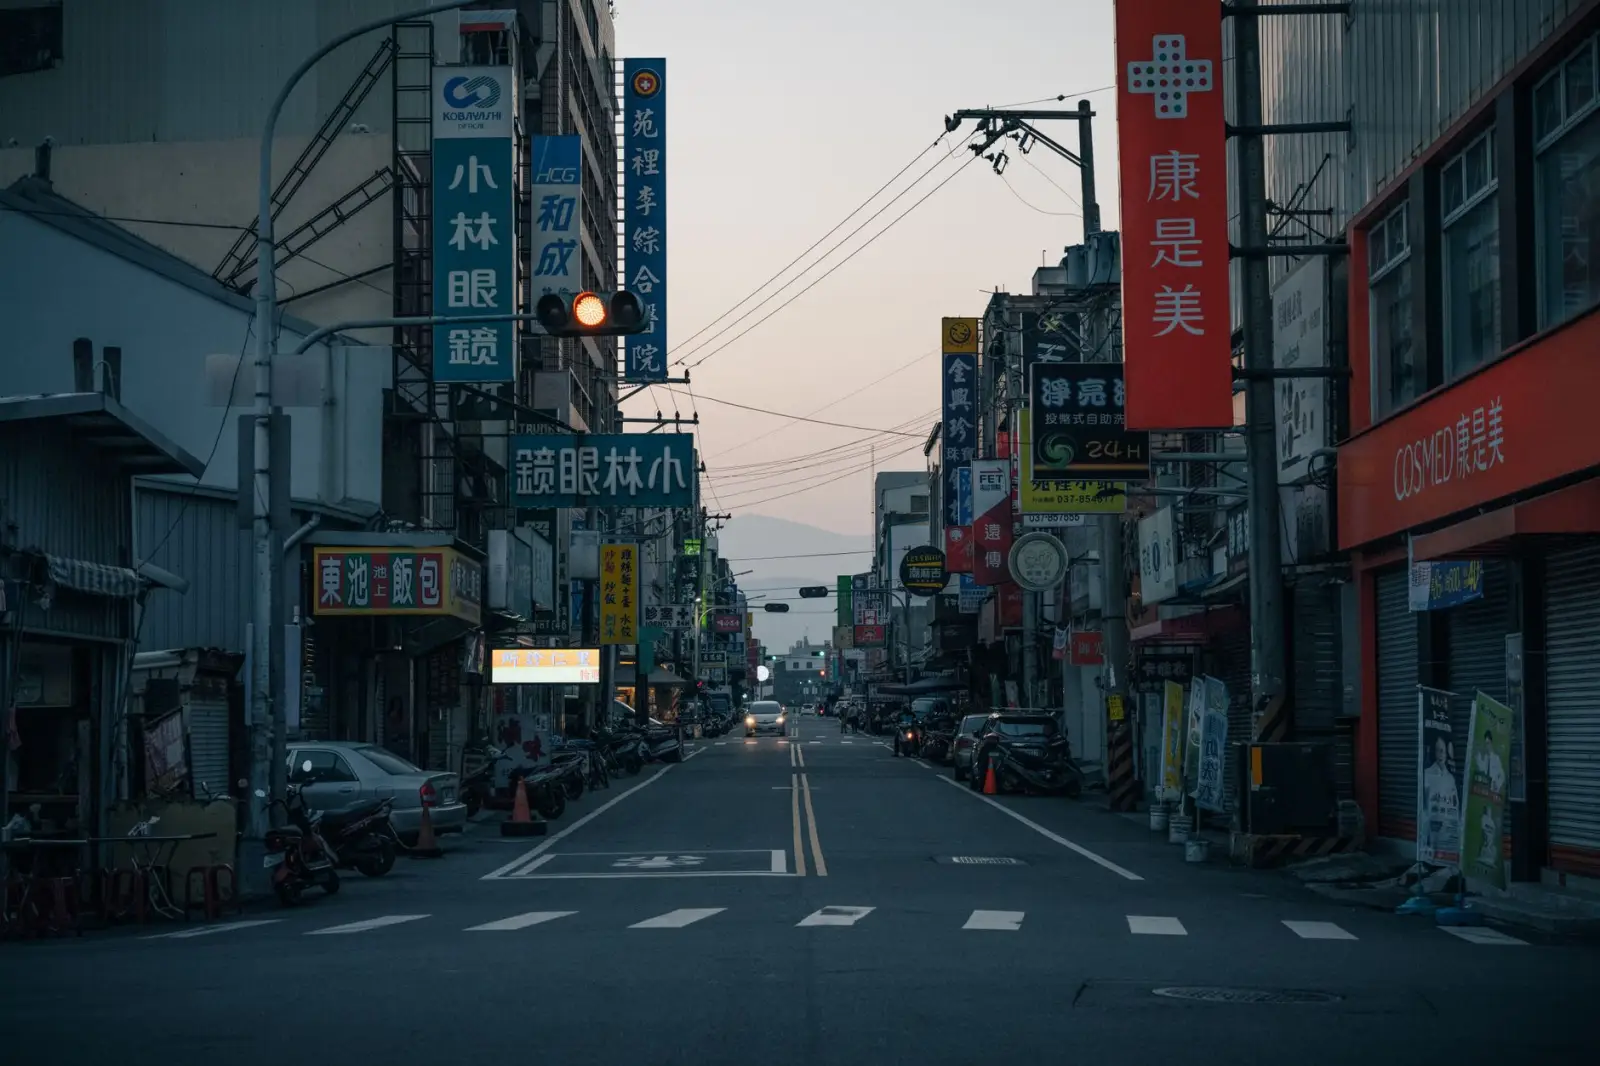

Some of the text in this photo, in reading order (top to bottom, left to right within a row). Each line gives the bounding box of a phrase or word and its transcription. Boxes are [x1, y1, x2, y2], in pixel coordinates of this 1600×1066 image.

[535, 167, 576, 183] HCG
[448, 155, 498, 365] 小林眼鏡
[534, 194, 577, 276] 和成
[1147, 150, 1204, 337] 康是美
[980, 475, 1003, 483] FET
[1394, 395, 1504, 501] COSMED 康是美
[984, 524, 1001, 568] 遠傳
[320, 556, 369, 607] 東池
[392, 556, 440, 606] 飯包
